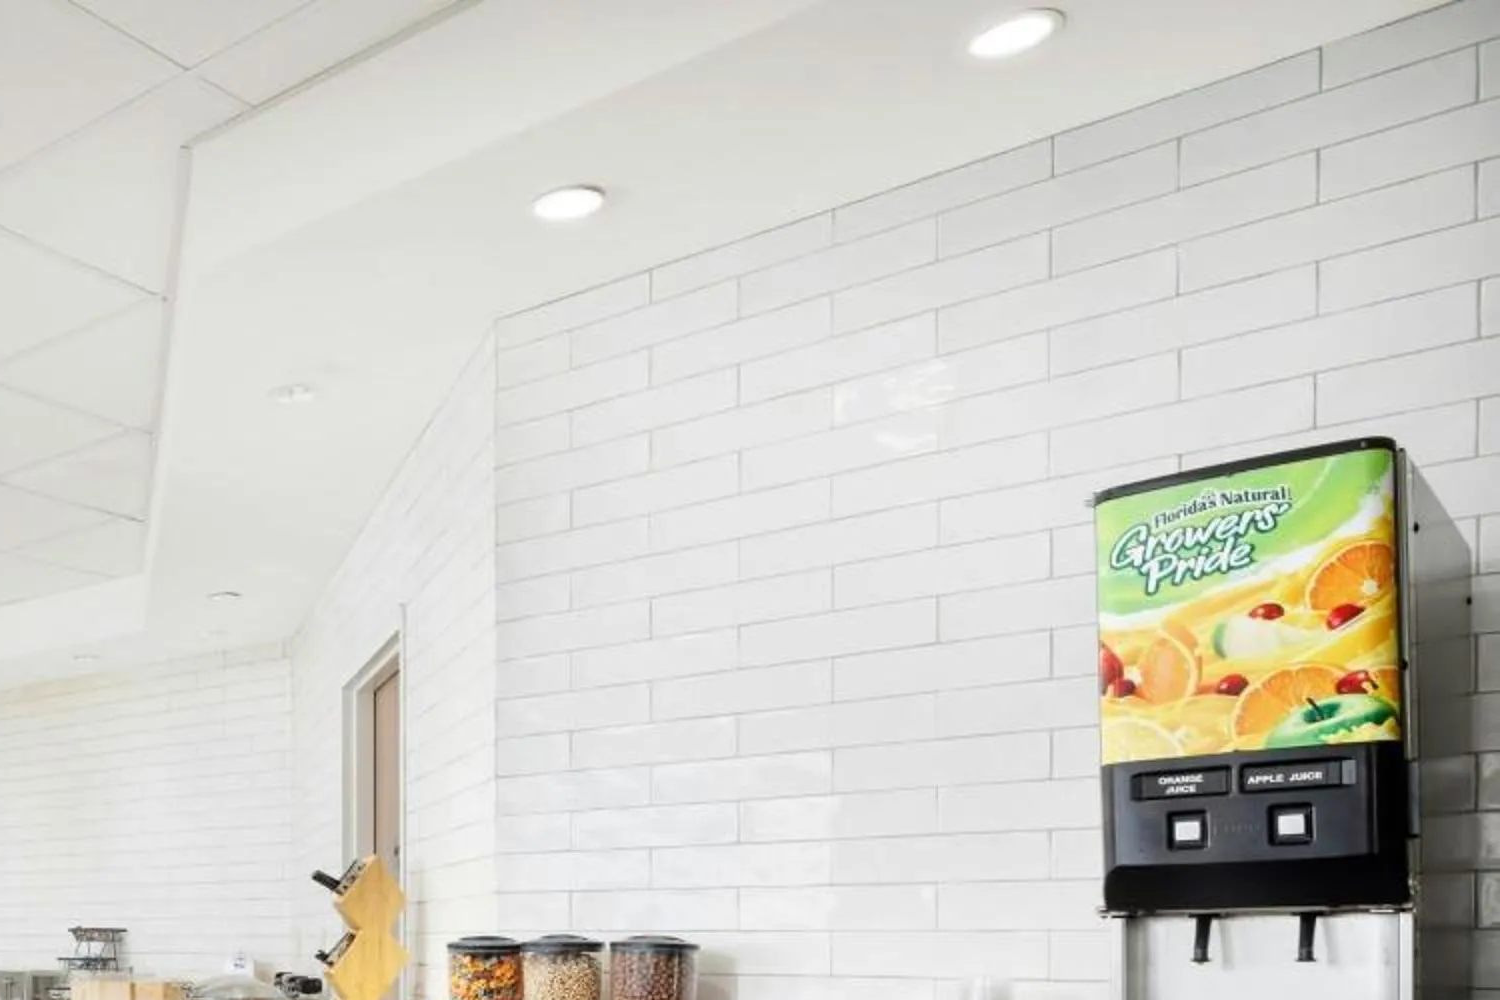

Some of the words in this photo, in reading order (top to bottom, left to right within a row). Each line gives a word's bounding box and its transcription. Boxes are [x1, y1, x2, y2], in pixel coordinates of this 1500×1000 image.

[1139, 536, 1257, 596] Pride
[1157, 774, 1204, 786] ORANGE
[1247, 773, 1285, 785] APPLE
[1288, 771, 1323, 782] JUICE
[1165, 784, 1196, 794] JUICE
